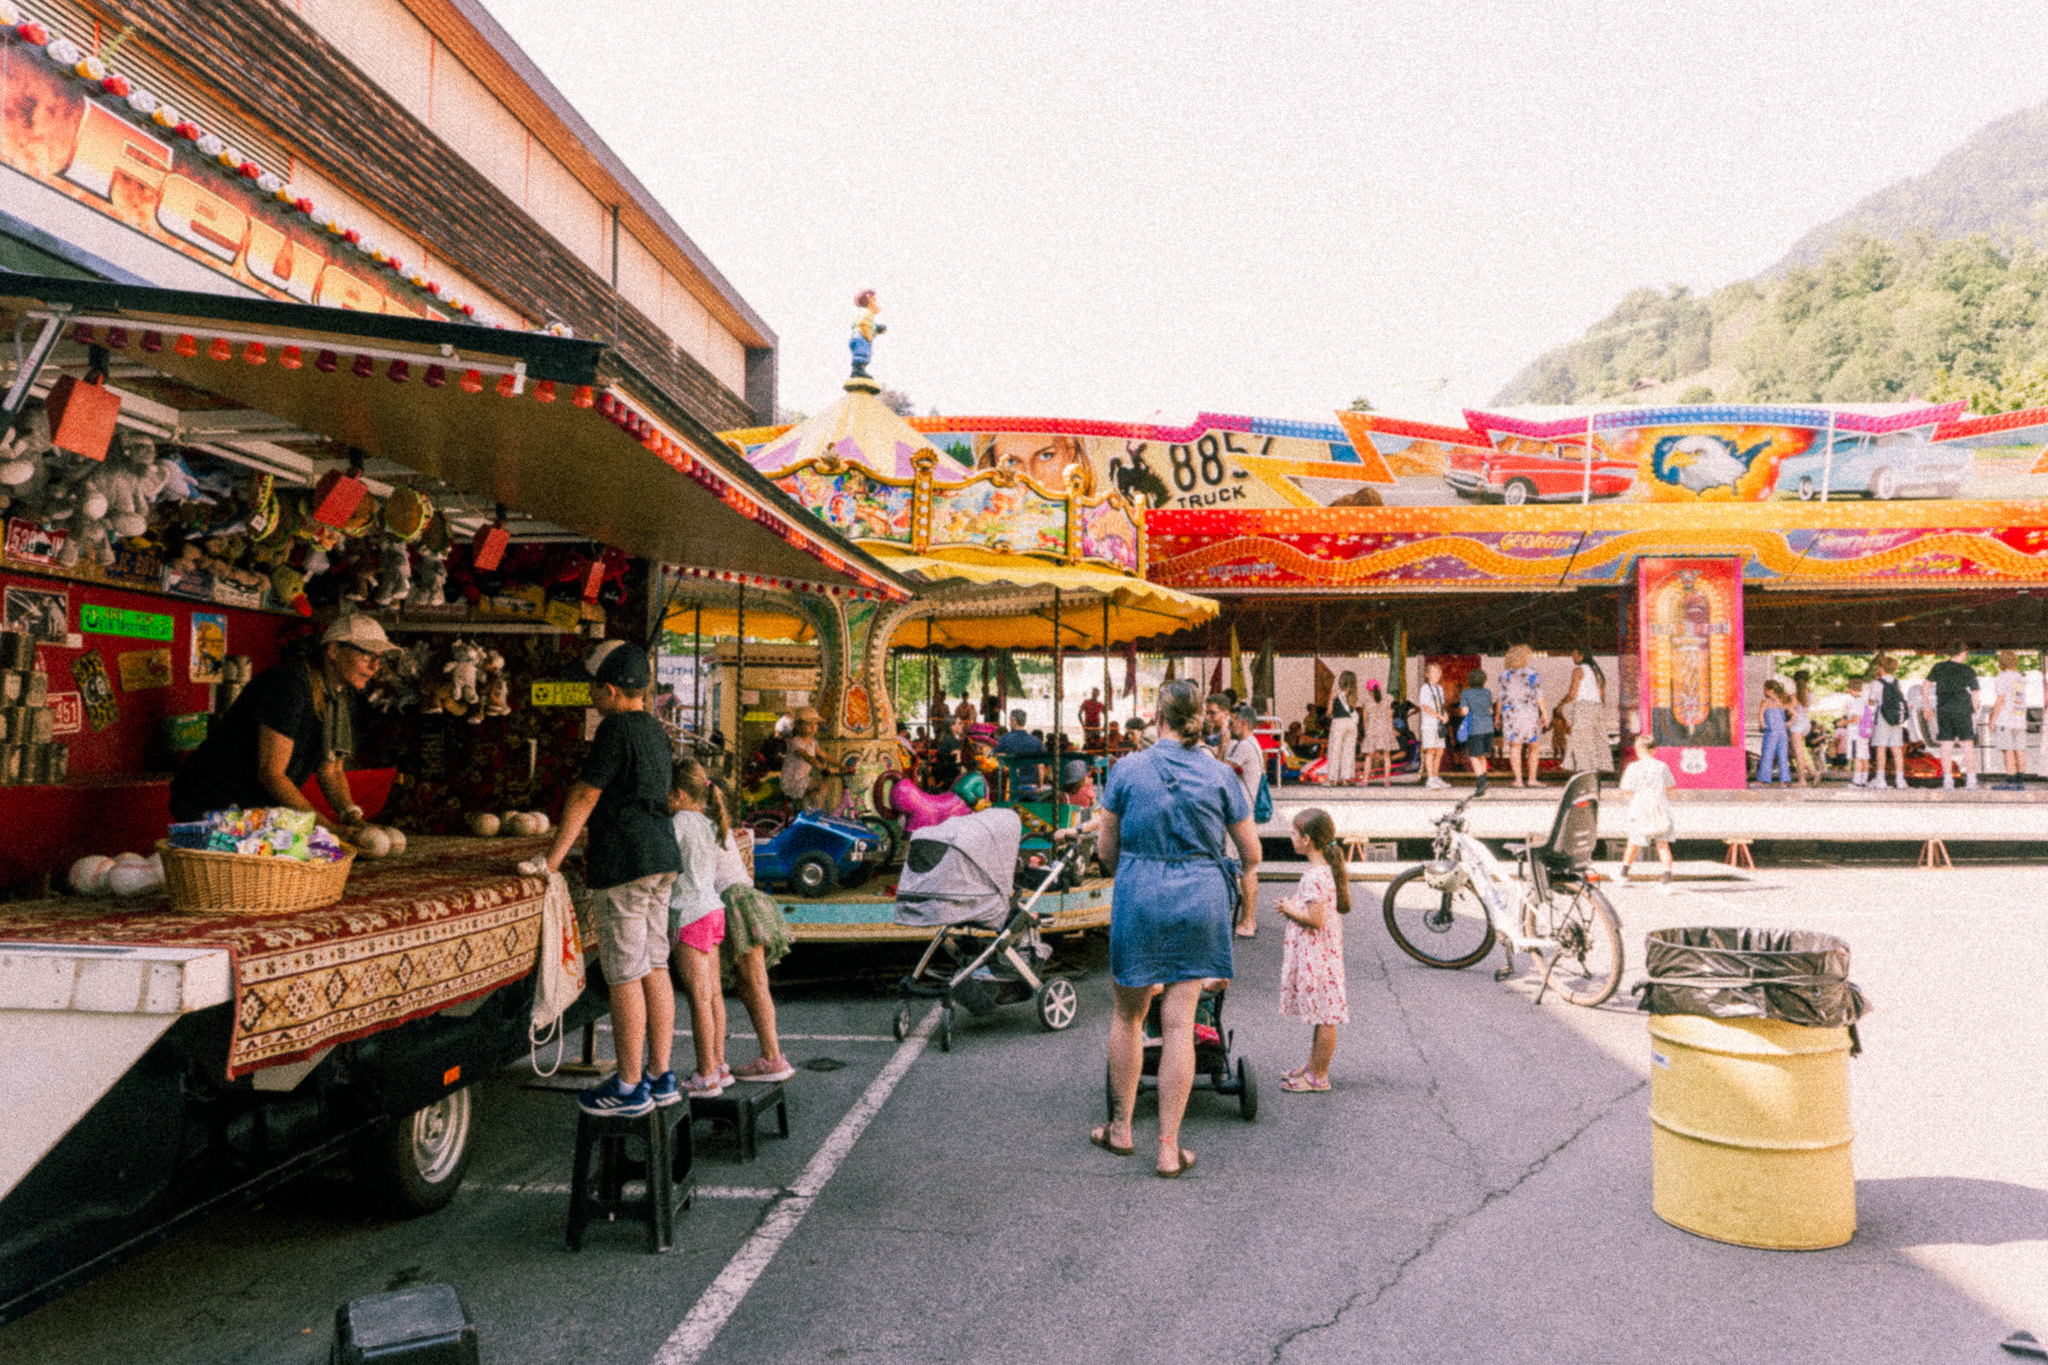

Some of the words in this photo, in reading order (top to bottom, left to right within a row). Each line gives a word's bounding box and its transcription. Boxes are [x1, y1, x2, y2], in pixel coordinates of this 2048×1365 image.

[62, 96, 451, 323] Feue
[1177, 485, 1246, 508] TRUCK
[1500, 532, 1572, 551] GEORGIA
[1208, 562, 1275, 578] DELAWARE
